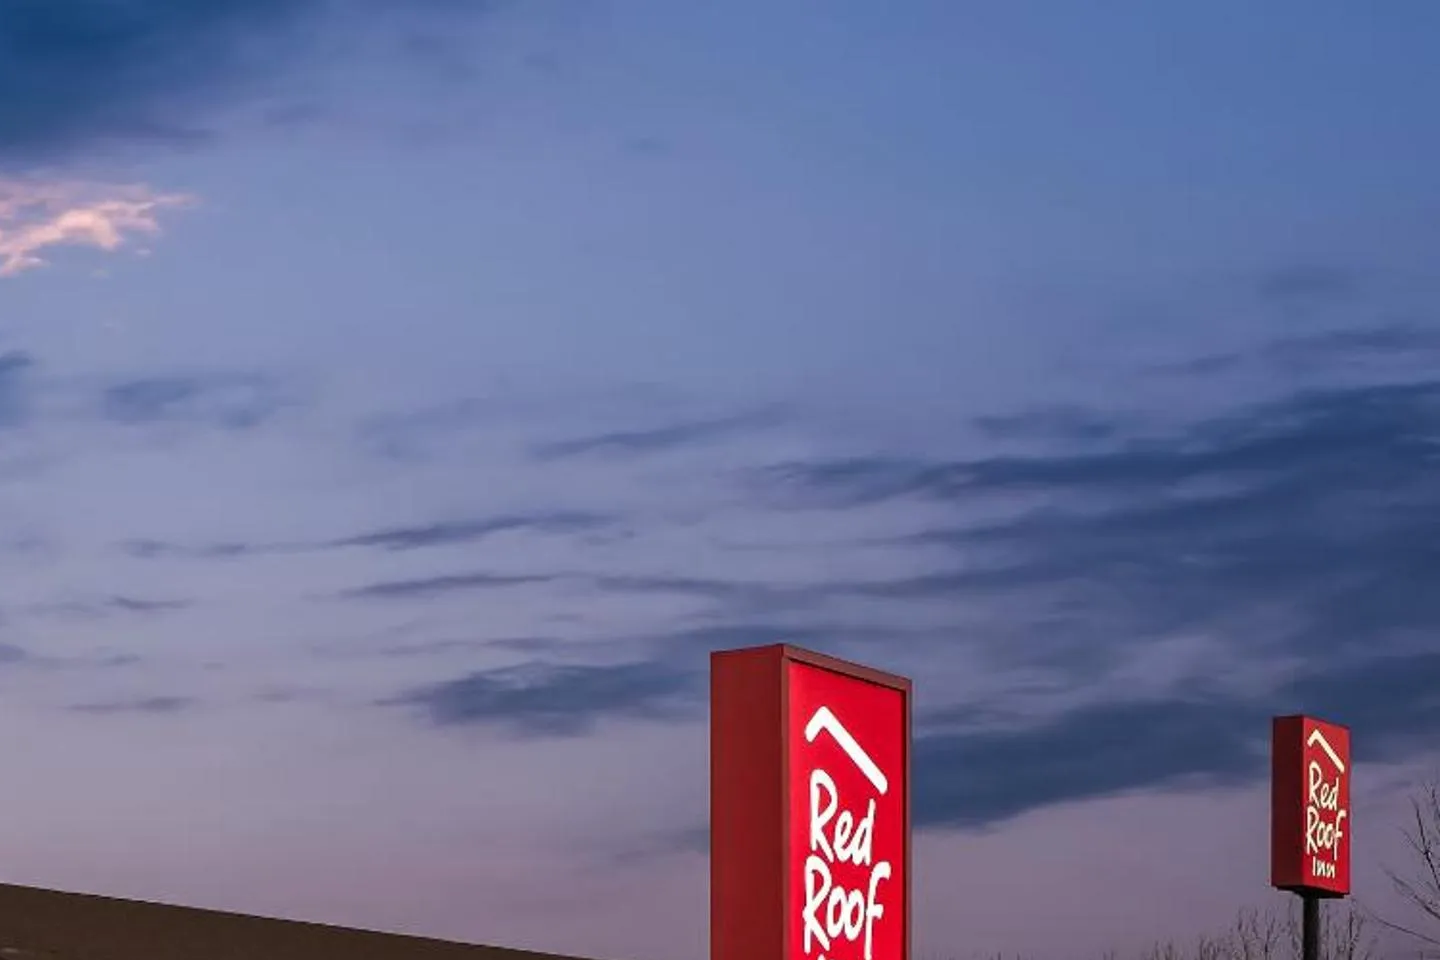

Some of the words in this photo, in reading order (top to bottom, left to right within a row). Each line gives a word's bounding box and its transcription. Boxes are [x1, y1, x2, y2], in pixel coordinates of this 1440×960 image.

[1310, 761, 1339, 811] Red
[810, 768, 875, 866] Red
[1306, 806, 1346, 861] Roof
[1312, 856, 1336, 878] Inn
